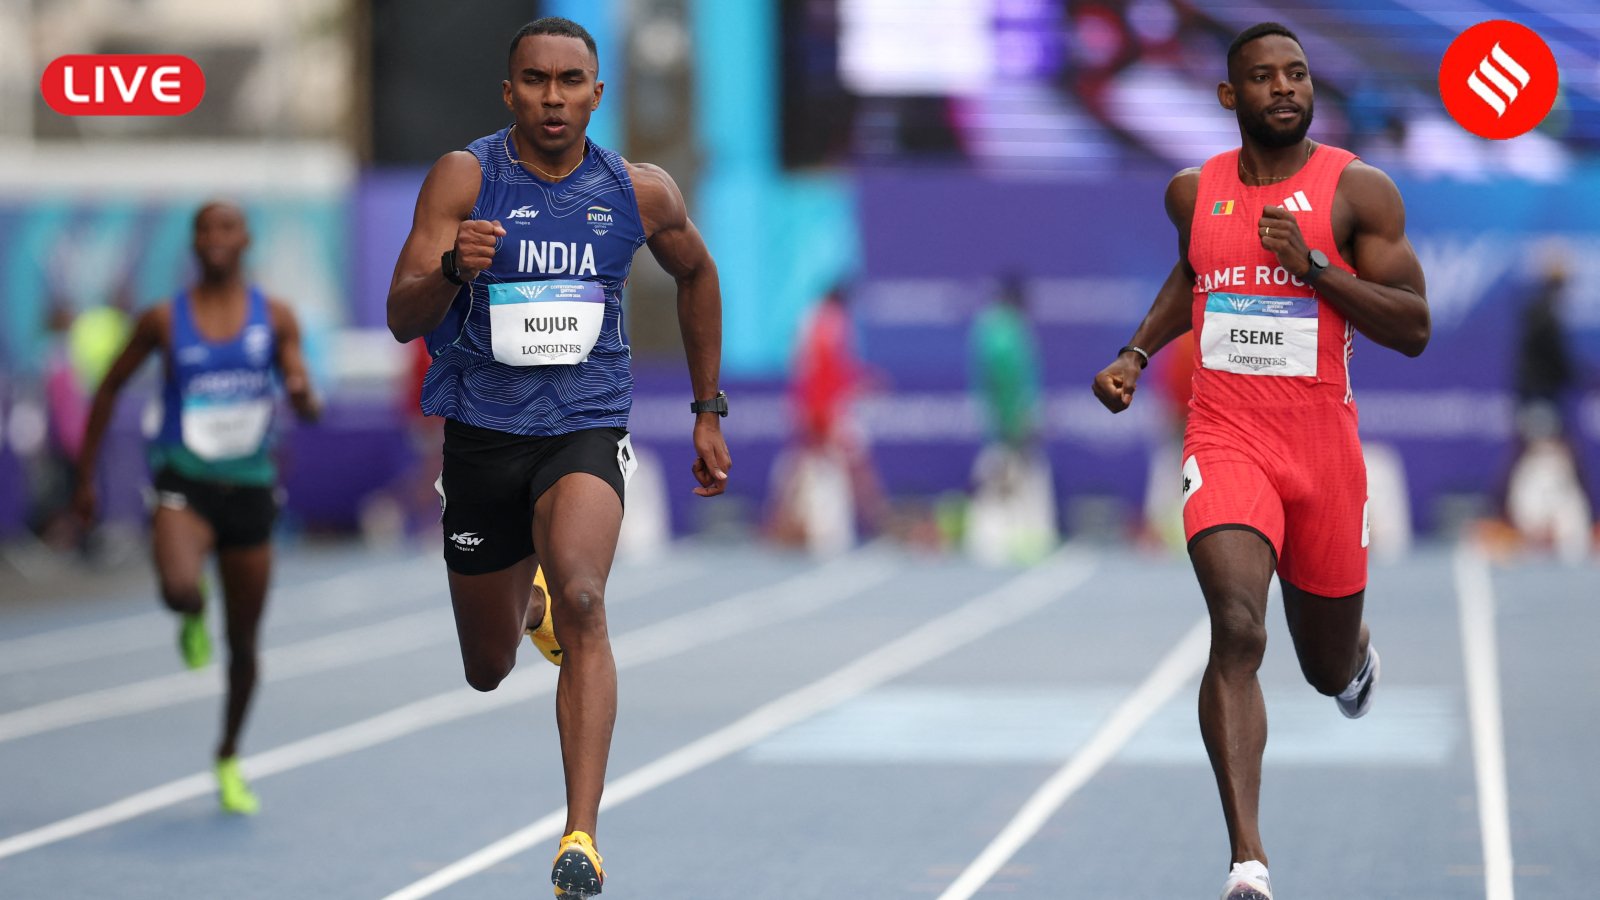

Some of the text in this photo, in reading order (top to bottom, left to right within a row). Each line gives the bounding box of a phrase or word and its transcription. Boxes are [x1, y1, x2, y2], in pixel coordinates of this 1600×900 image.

[506, 206, 540, 219] JSW
[586, 213, 614, 223] INDIA
[518, 239, 597, 276] INDIA
[524, 316, 579, 335] KUJUR
[1230, 328, 1285, 345] ESEME
[522, 343, 582, 355] LONGINES
[1227, 353, 1287, 366] LONGINES
[449, 532, 484, 546] JSW
